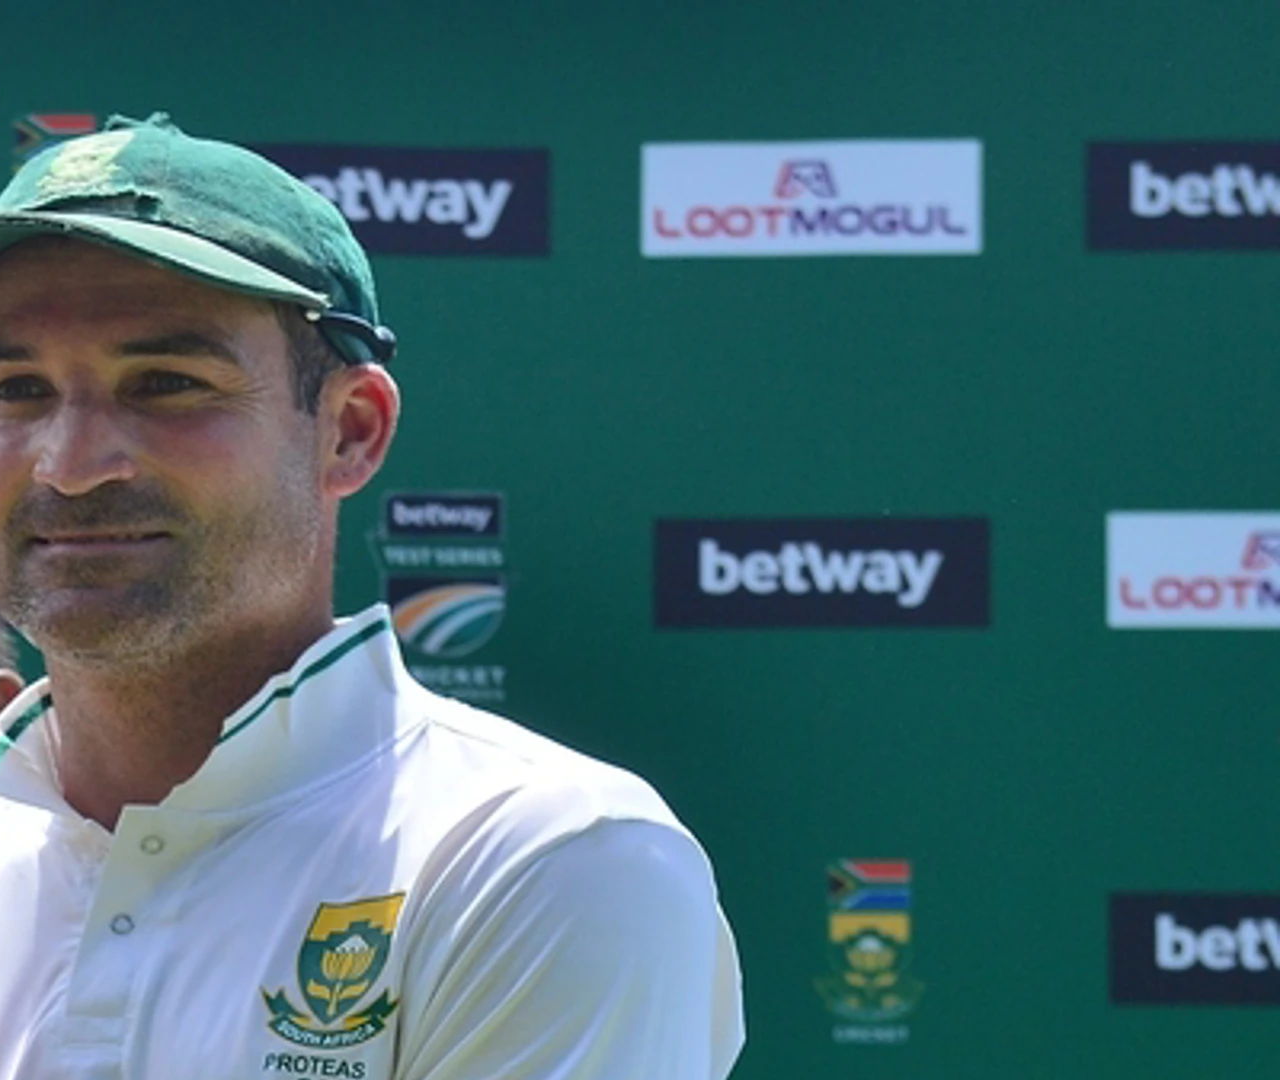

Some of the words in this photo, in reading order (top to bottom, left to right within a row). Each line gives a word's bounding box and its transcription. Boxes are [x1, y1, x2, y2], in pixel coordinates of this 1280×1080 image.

[304, 167, 513, 239] tway
[1130, 160, 1280, 217] betw
[654, 204, 967, 239] LOOTMOGUL
[393, 502, 493, 531] betway
[699, 540, 943, 607] betway
[1119, 576, 1280, 611] LOOTM
[1155, 913, 1280, 971] bet
[263, 1053, 366, 1080] PROTEAS
